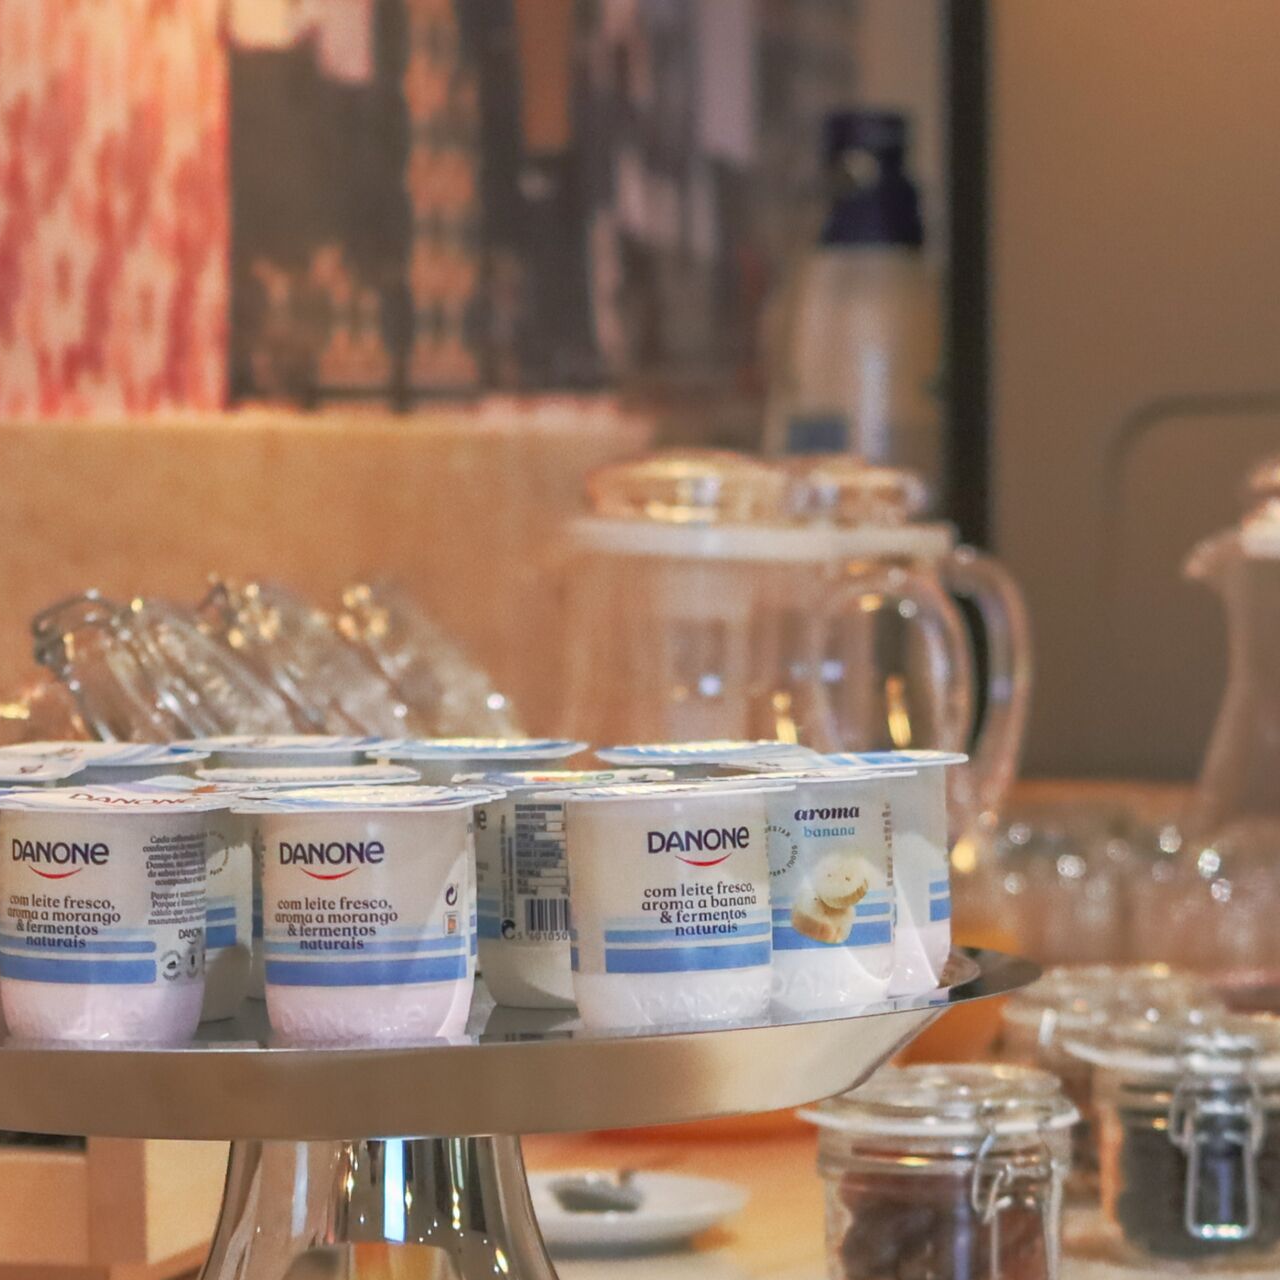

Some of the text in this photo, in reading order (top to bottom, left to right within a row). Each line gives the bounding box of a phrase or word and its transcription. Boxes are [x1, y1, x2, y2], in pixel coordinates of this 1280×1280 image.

[794, 806, 860, 821] aroma
[803, 825, 856, 838] banana
[644, 880, 755, 898] com leite fresco,
[9, 893, 116, 911] com leite fresco,
[277, 896, 393, 911] com leite fresco,
[641, 894, 757, 912] aroma a banana
[7, 907, 121, 925] aroma a morango
[275, 911, 398, 926] aroma a morango
[659, 908, 747, 924] & fermentos
[16, 918, 99, 936] & fermentos
[287, 923, 377, 937] & fermentos
[675, 920, 738, 937] naturais
[25, 934, 86, 949] naturais
[299, 936, 365, 951] naturais
